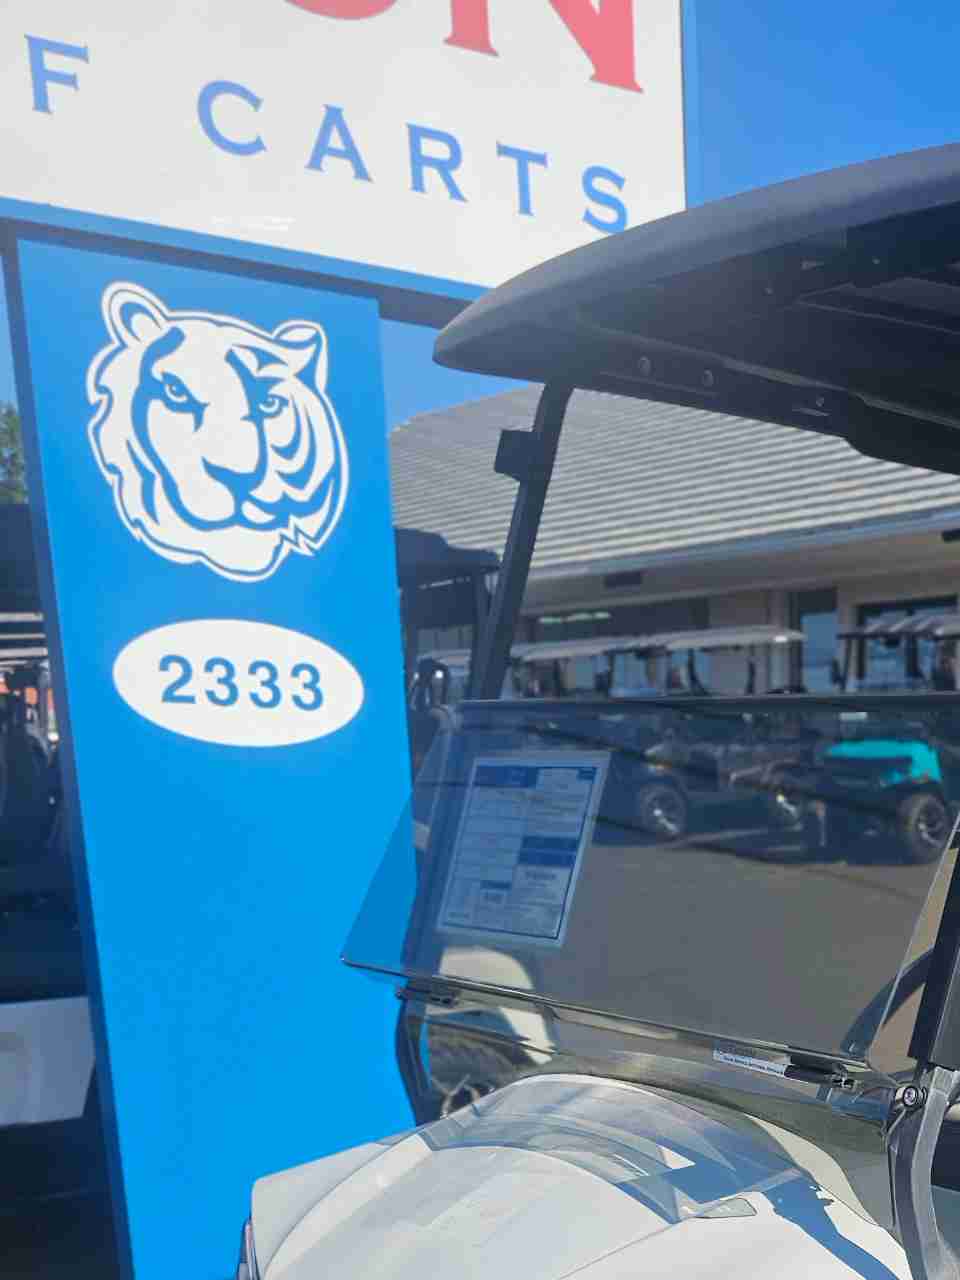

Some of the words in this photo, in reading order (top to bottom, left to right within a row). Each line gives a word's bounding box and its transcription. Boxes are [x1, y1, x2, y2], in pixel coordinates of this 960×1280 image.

[24, 34, 89, 114] F
[195, 80, 628, 234] CARTS
[159, 654, 323, 711] 2333
